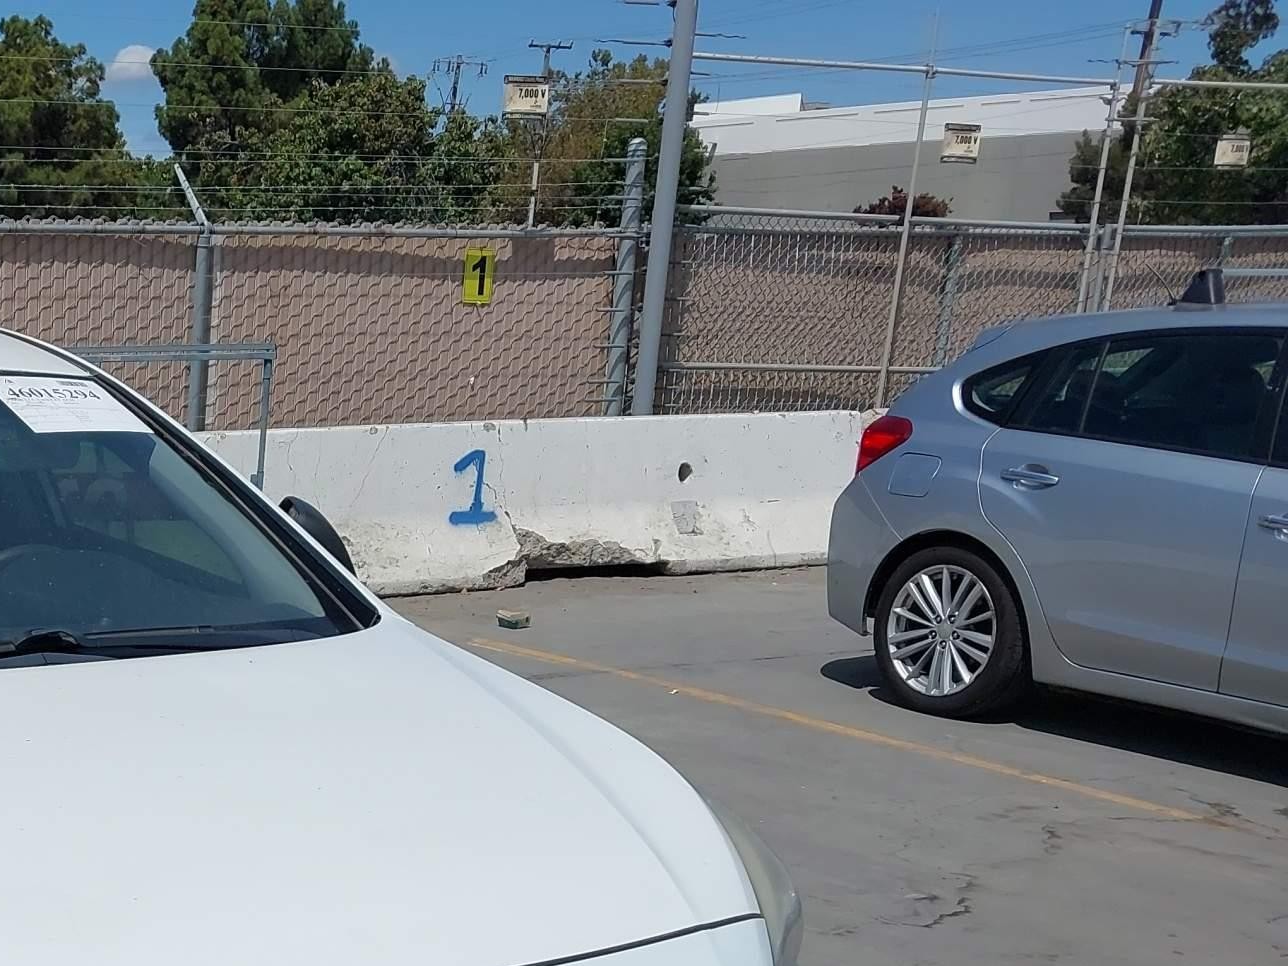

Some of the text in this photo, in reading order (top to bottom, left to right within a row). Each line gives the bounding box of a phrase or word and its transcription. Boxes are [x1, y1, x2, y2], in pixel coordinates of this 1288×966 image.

[518, 88, 546, 100] 7,000 V
[472, 255, 487, 296] 1
[7, 387, 101, 401] 46015294
[449, 449, 498, 526] 1
